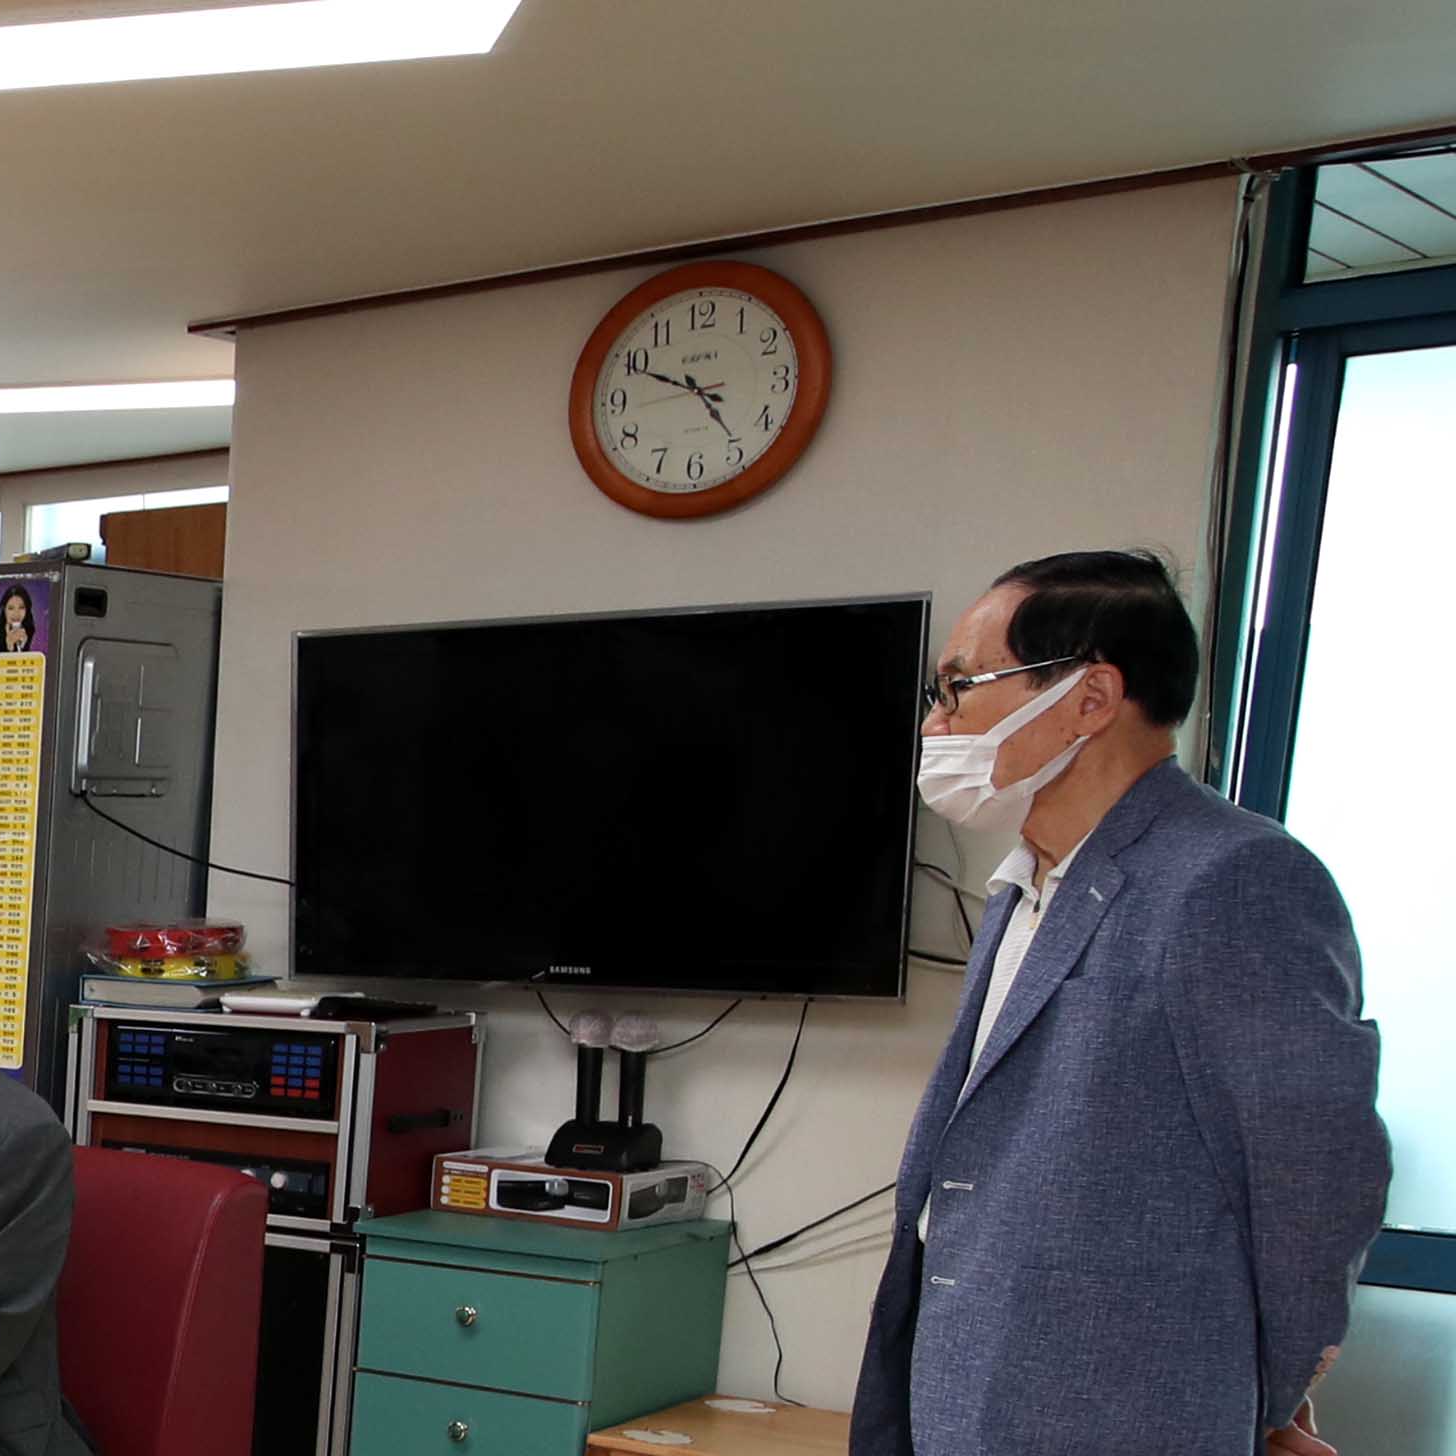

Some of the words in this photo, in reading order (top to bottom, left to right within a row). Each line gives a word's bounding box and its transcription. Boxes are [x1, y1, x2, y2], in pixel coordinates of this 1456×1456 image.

[687, 300, 717, 331] 12
[735, 306, 746, 334] 1
[650, 319, 671, 348] 11
[759, 327, 778, 357] 2
[623, 348, 649, 377] 10
[770, 365, 790, 393] 3
[609, 388, 627, 416] 9
[753, 404, 774, 432] 4
[620, 423, 639, 449] 8
[651, 448, 668, 475] 7
[725, 438, 744, 466] 5
[686, 453, 704, 481] 6
[549, 965, 591, 975] SAMSUNG
